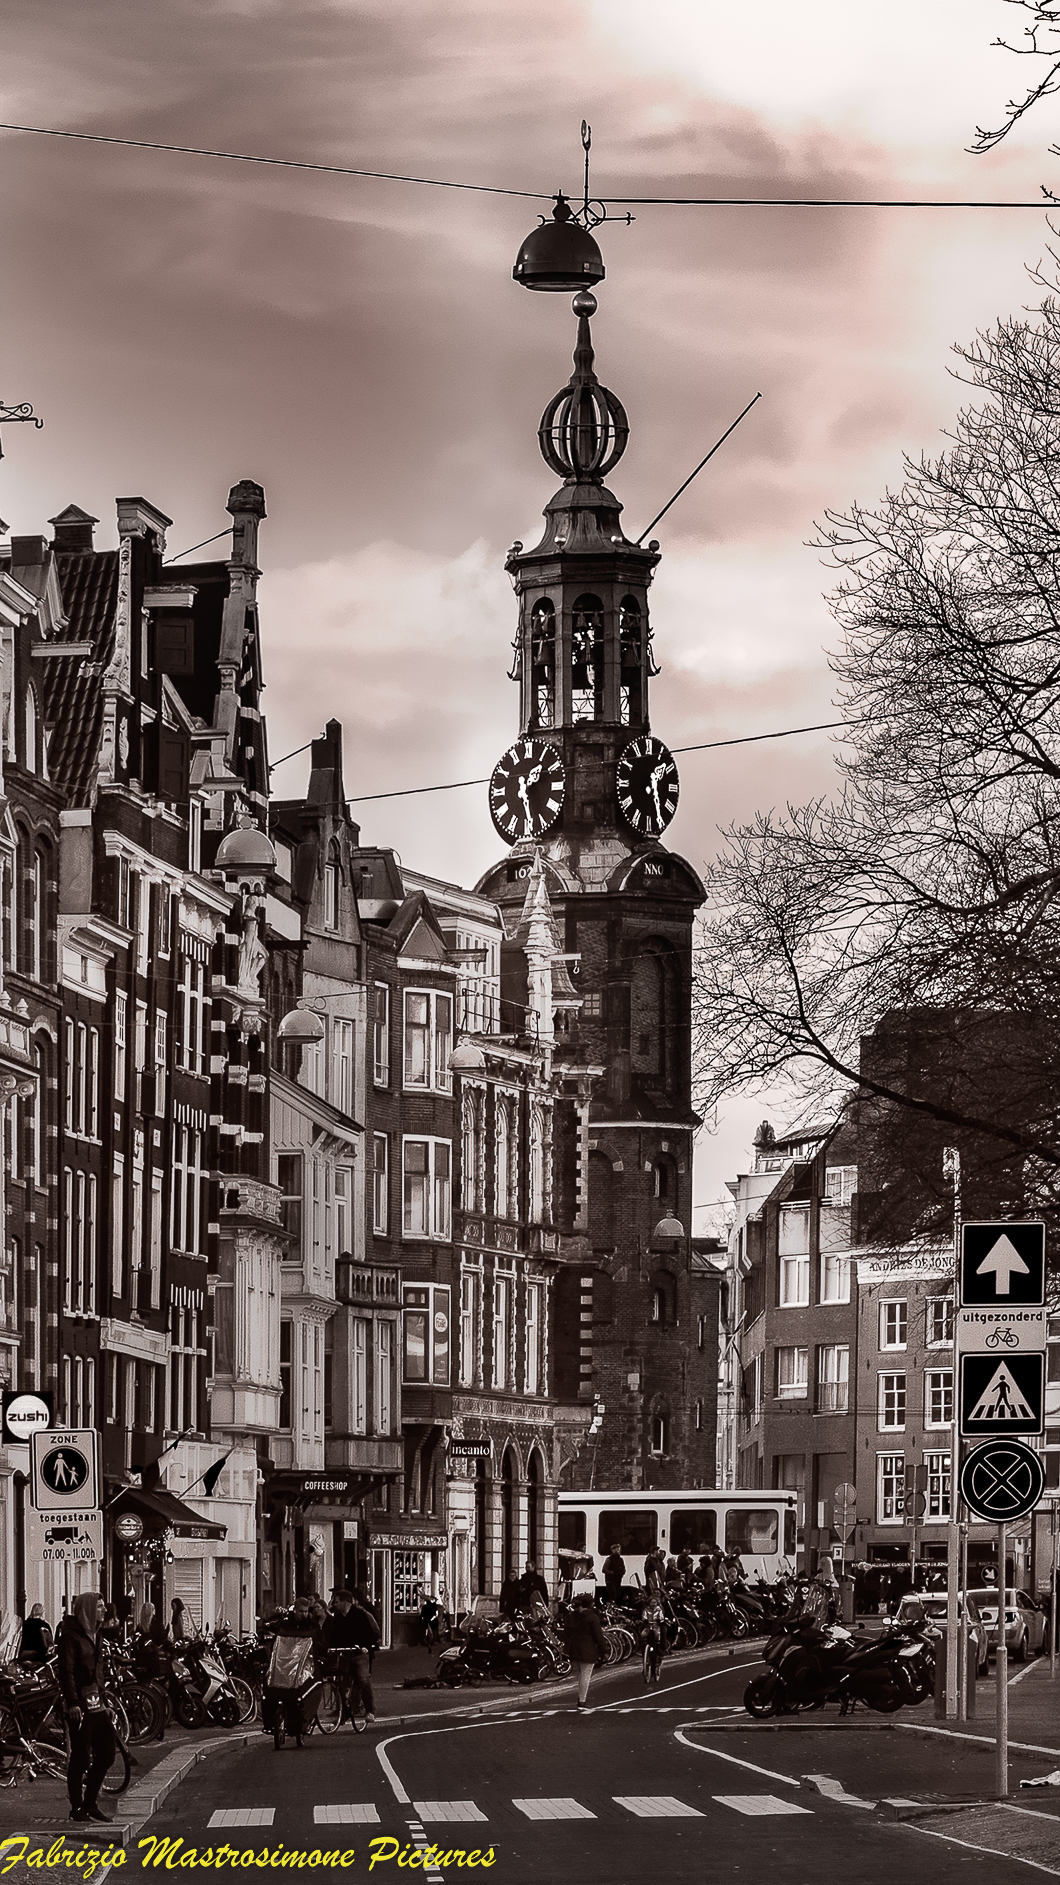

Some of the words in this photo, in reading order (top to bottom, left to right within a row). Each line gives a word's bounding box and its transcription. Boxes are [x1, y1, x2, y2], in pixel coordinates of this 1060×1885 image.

[963, 1311, 1042, 1324] uitgezonderd
[7, 1410, 48, 1422] zushi
[50, 1436, 78, 1444] ZONE
[452, 1443, 490, 1456] incanto
[304, 1481, 348, 1491] COFFEESHOP
[40, 1513, 97, 1525] toegestaan
